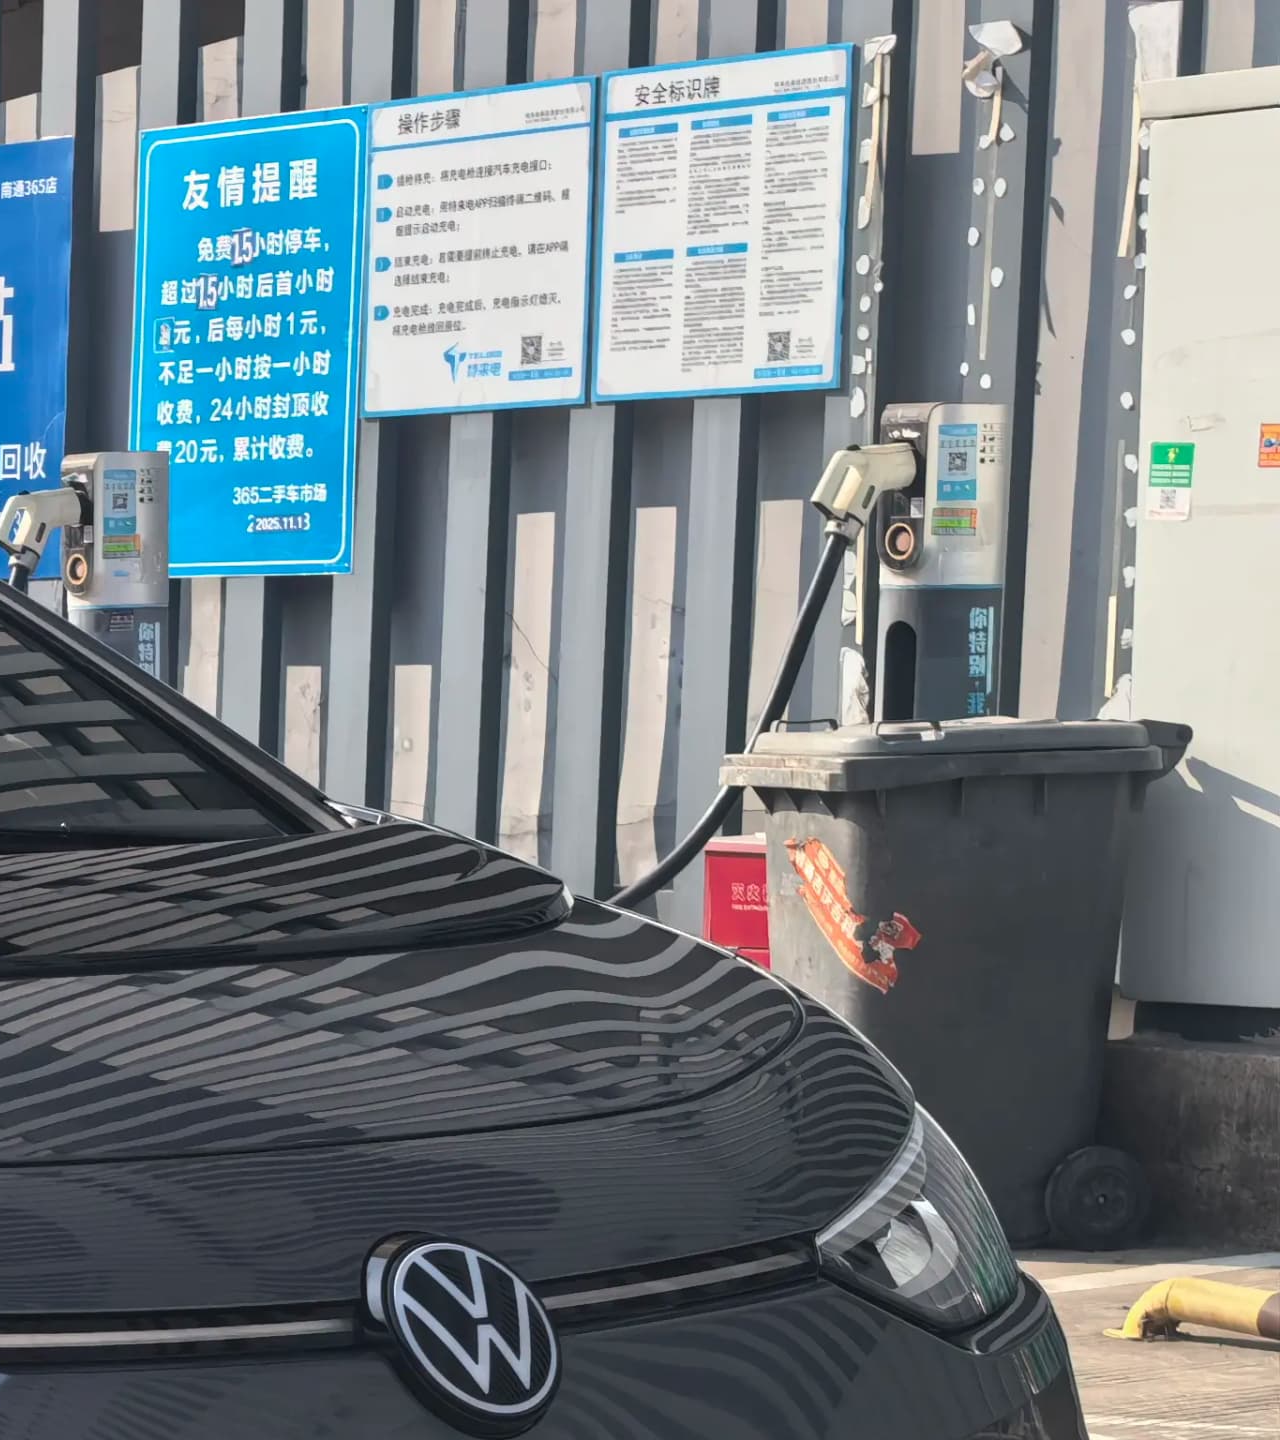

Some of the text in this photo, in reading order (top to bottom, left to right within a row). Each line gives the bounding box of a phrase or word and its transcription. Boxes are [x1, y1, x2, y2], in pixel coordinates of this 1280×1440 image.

[634, 76, 721, 107] 安全标识牌
[397, 108, 461, 136] 操作步骤
[1, 176, 58, 199] 南通365店
[182, 158, 319, 211] 友情提醒
[158, 310, 327, 346] 元，后每小时1元，
[158, 350, 332, 386] 不足一小时按一小时
[156, 391, 330, 426] 收费，24小时封顶收
[0, 442, 47, 481] 回收
[233, 483, 327, 505] 365二手车市场
